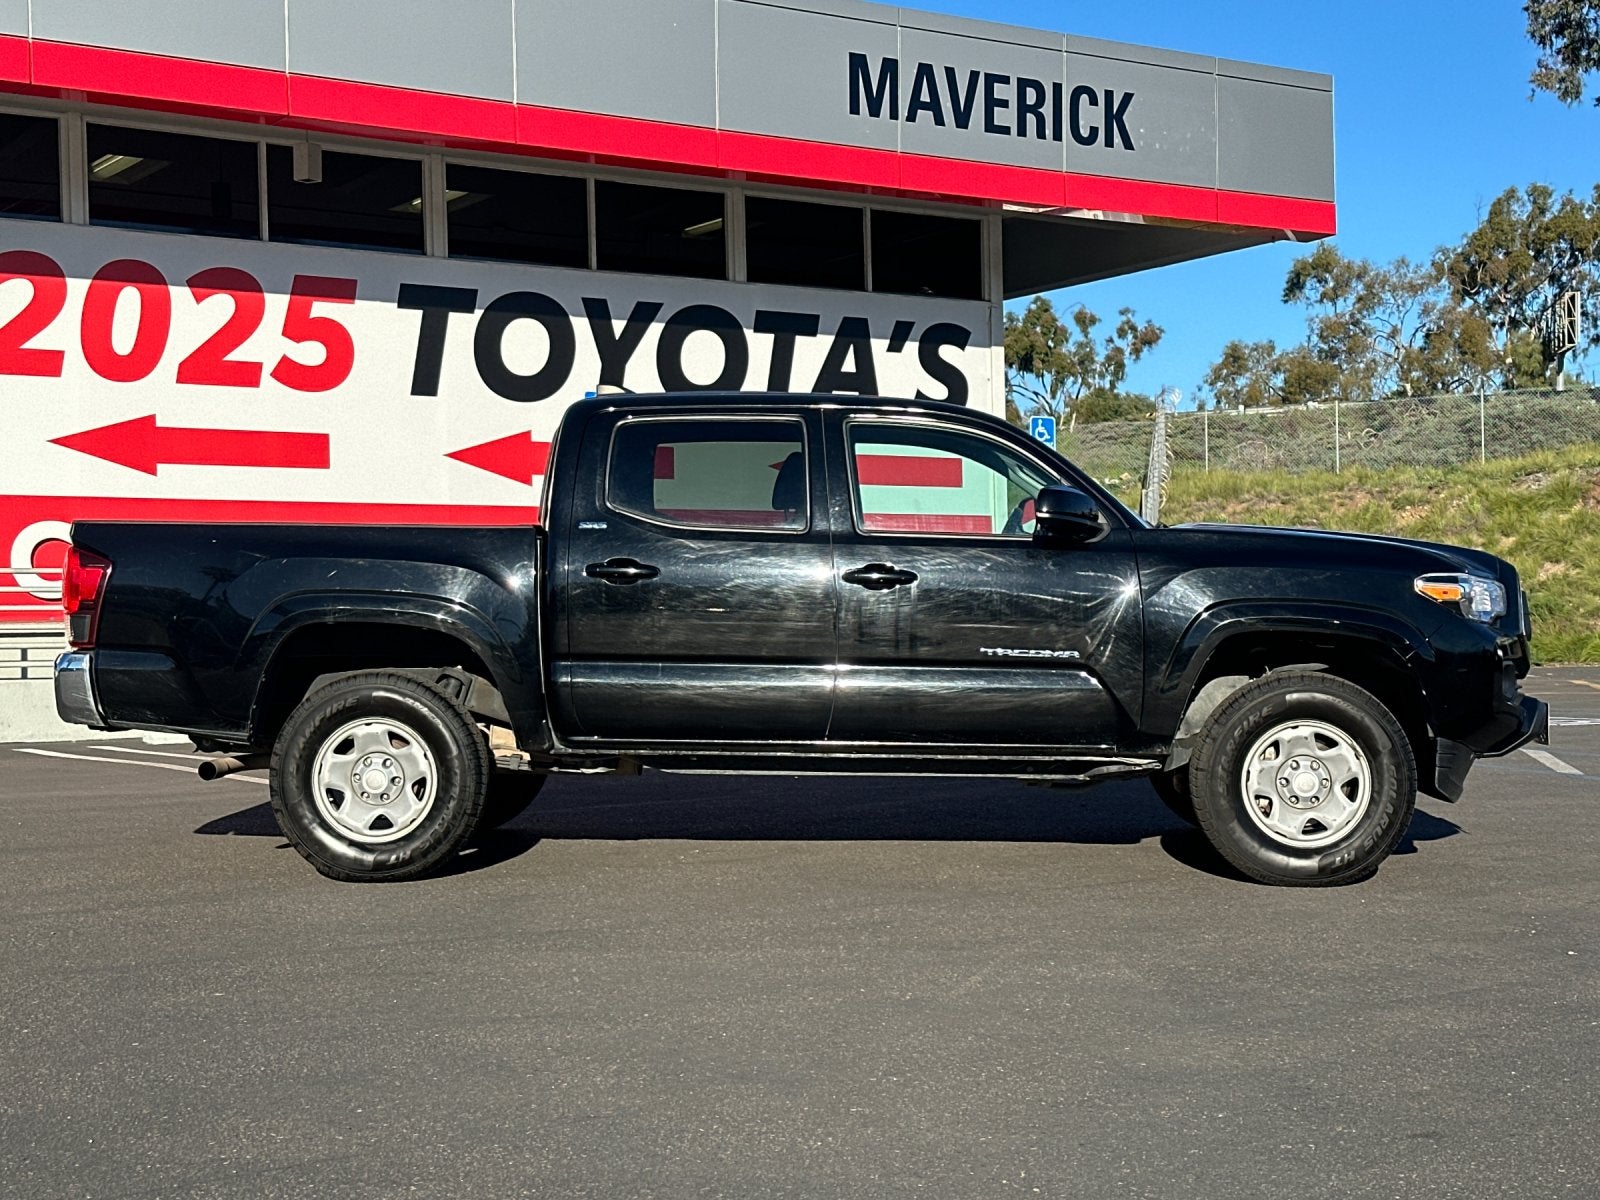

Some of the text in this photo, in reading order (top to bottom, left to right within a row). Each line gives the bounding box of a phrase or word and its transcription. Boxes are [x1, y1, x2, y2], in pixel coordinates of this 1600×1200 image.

[848, 51, 1136, 152] MAVERICK
[0, 250, 972, 406] 2025 TOYOTA'S
[979, 647, 1080, 658] TACOMA
